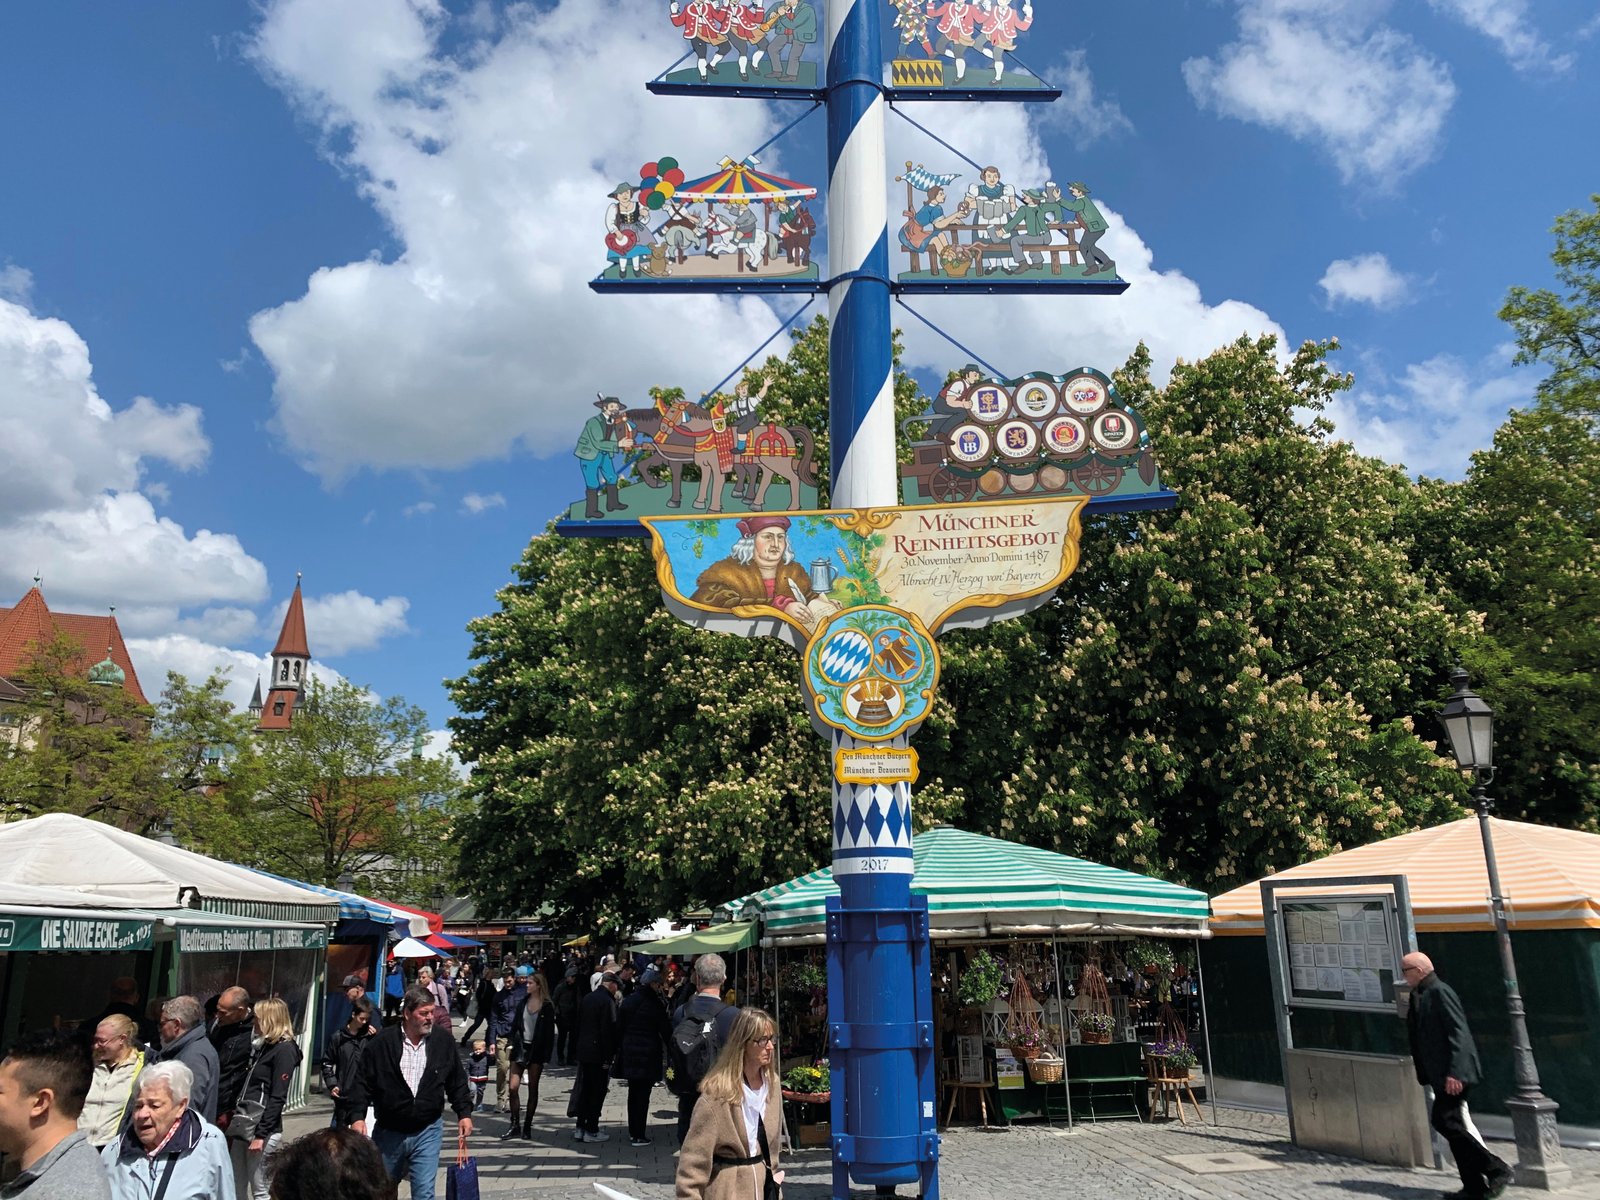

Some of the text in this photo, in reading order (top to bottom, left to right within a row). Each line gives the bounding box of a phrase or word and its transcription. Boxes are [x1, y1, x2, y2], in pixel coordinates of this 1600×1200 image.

[963, 442, 977, 453] HB
[918, 511, 1039, 533] MÜNCHNER
[893, 531, 1060, 556] REINHEITSGEBOT
[917, 553, 963, 566] November
[964, 552, 990, 563] Anno
[990, 550, 1023, 562] Domini
[1025, 549, 1050, 564] 1487
[898, 567, 939, 587] Albrecht
[950, 569, 984, 592] Herzog
[986, 574, 1003, 582] von
[1005, 567, 1042, 584] Bayern
[842, 752, 911, 761] Den Münchner Bürgern
[844, 766, 911, 774] Münchner Brauereien
[861, 859, 889, 871] 2017
[41, 920, 61, 948] DIE
[63, 920, 94, 948] SAURE
[94, 922, 120, 948] ECKE
[118, 930, 134, 948] seit
[180, 928, 223, 951] Mediterrane
[223, 929, 249, 950] Feinkost
[249, 930, 254, 950] &
